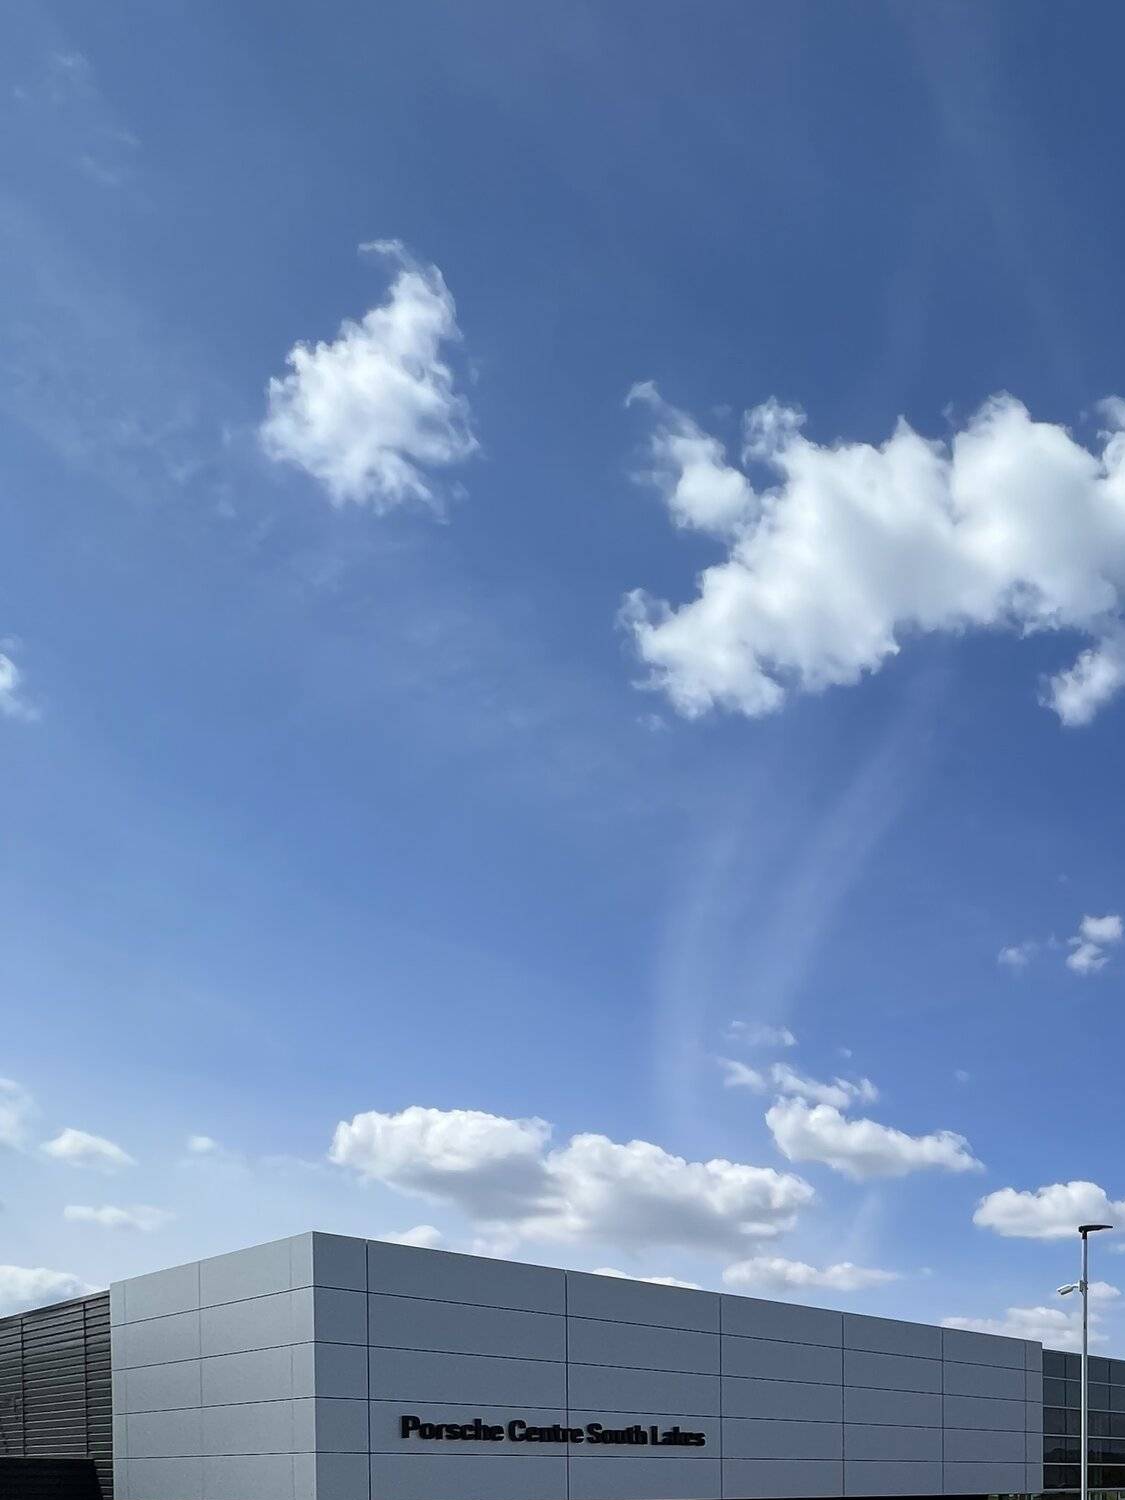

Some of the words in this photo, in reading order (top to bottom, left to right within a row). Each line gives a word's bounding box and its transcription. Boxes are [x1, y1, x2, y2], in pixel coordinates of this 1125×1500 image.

[400, 1415, 505, 1441] Porsche
[507, 1419, 585, 1443] Centre
[586, 1423, 648, 1445] South
[650, 1425, 706, 1446] Lakes
